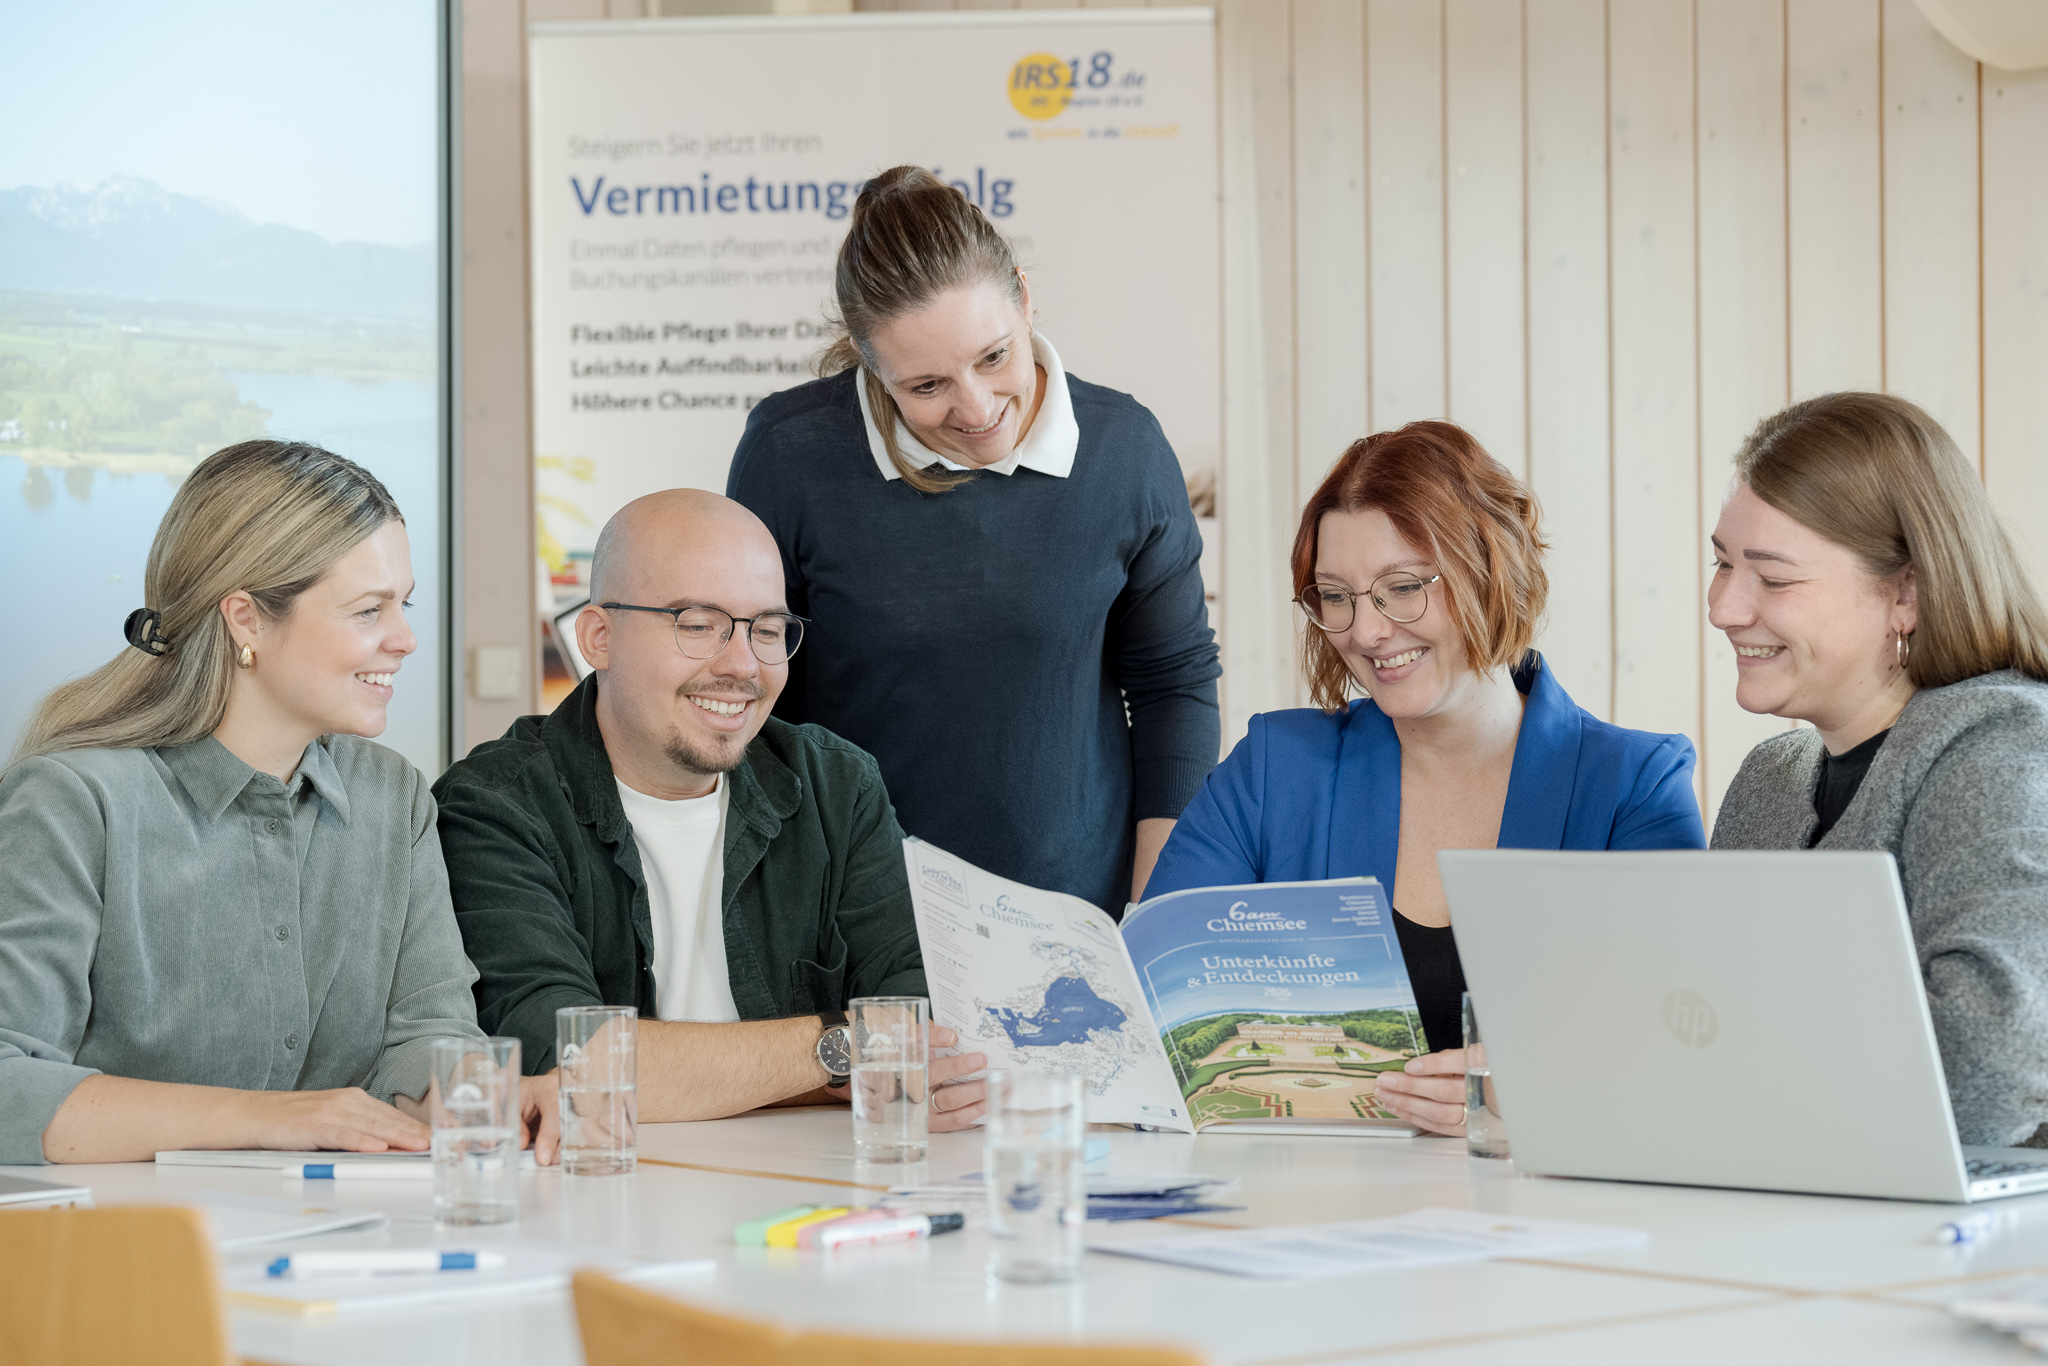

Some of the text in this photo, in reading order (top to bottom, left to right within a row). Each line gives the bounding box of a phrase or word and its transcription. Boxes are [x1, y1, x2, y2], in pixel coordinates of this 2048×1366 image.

[568, 130, 822, 162] Steigern Sie jetzt Ihren
[570, 323, 655, 345] Flexible
[661, 321, 730, 348] Pflege
[736, 321, 788, 340] Ihrer
[570, 358, 650, 379] Leichte
[1206, 918, 1308, 933] Chiemsee
[1201, 953, 1336, 970] Unterkünfte
[1187, 968, 1360, 989] & Entdeckungen
